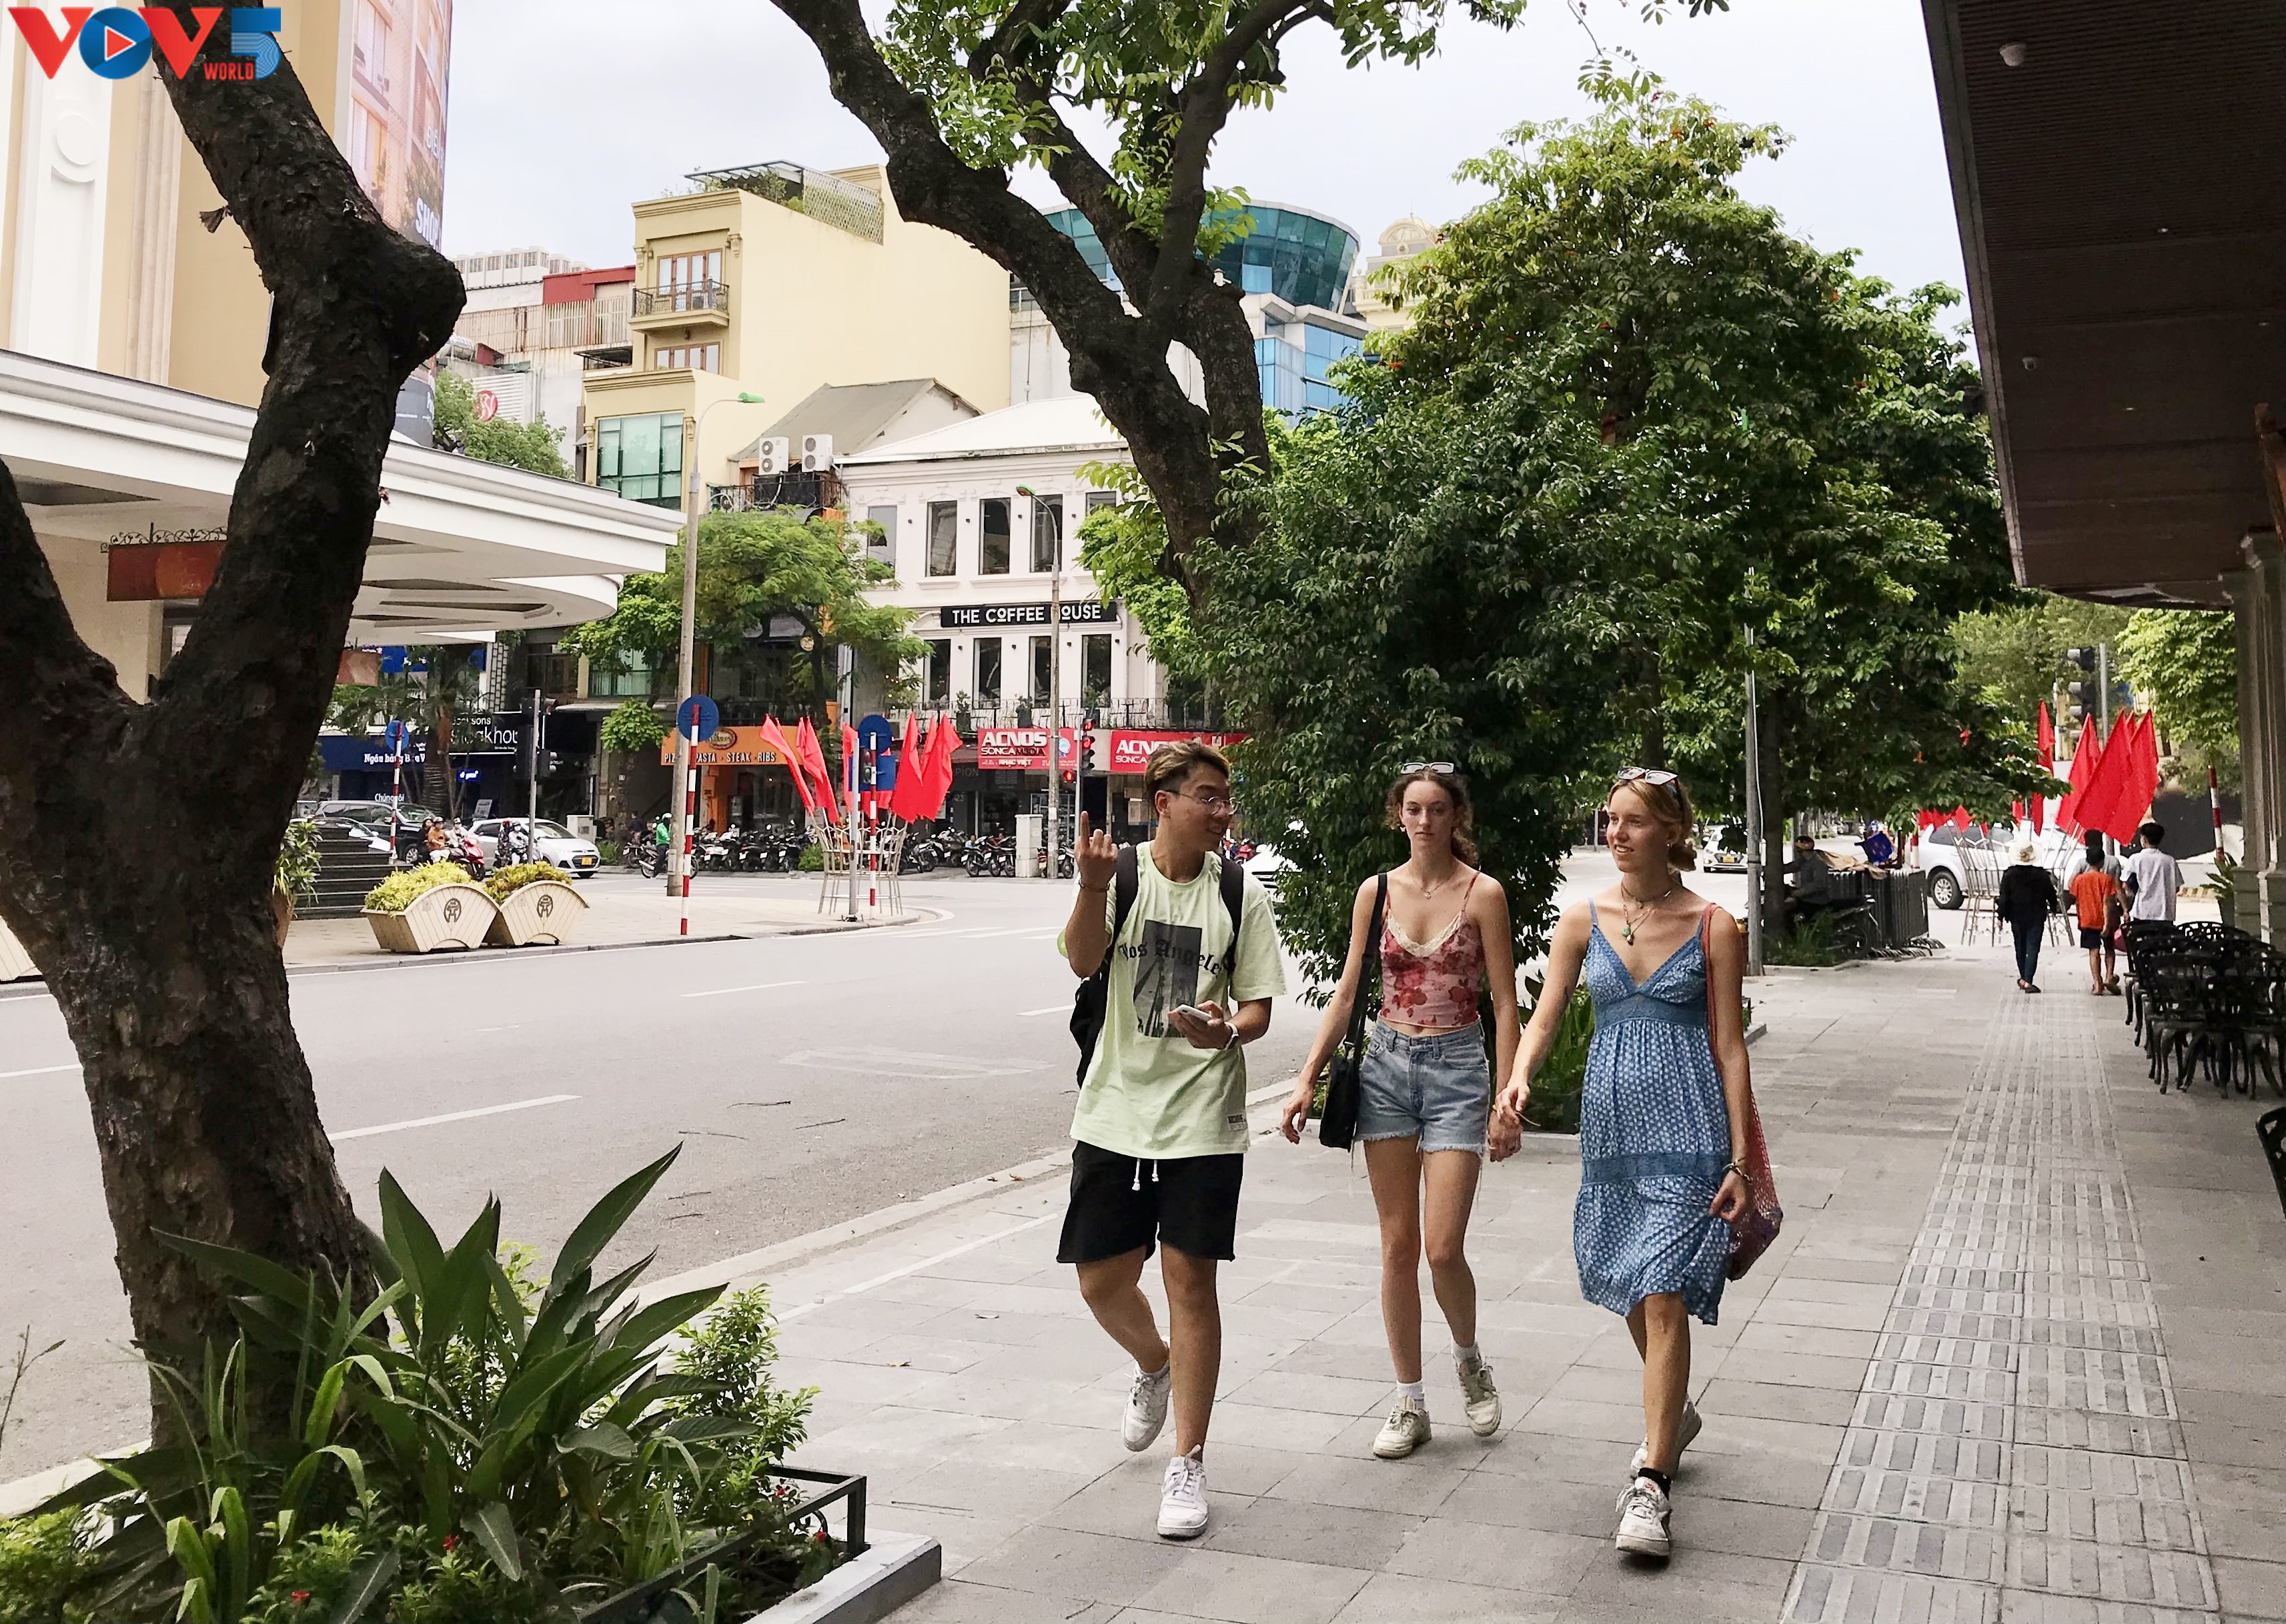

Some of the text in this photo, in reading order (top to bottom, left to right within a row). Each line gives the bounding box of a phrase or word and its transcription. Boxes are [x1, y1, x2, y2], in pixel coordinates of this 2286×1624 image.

[953, 609, 980, 624] THE
[985, 606, 1045, 623] COFFEE
[981, 731, 1048, 748] ACNOS
[726, 752, 751, 763] STEAK
[757, 752, 776, 762] RIBS
